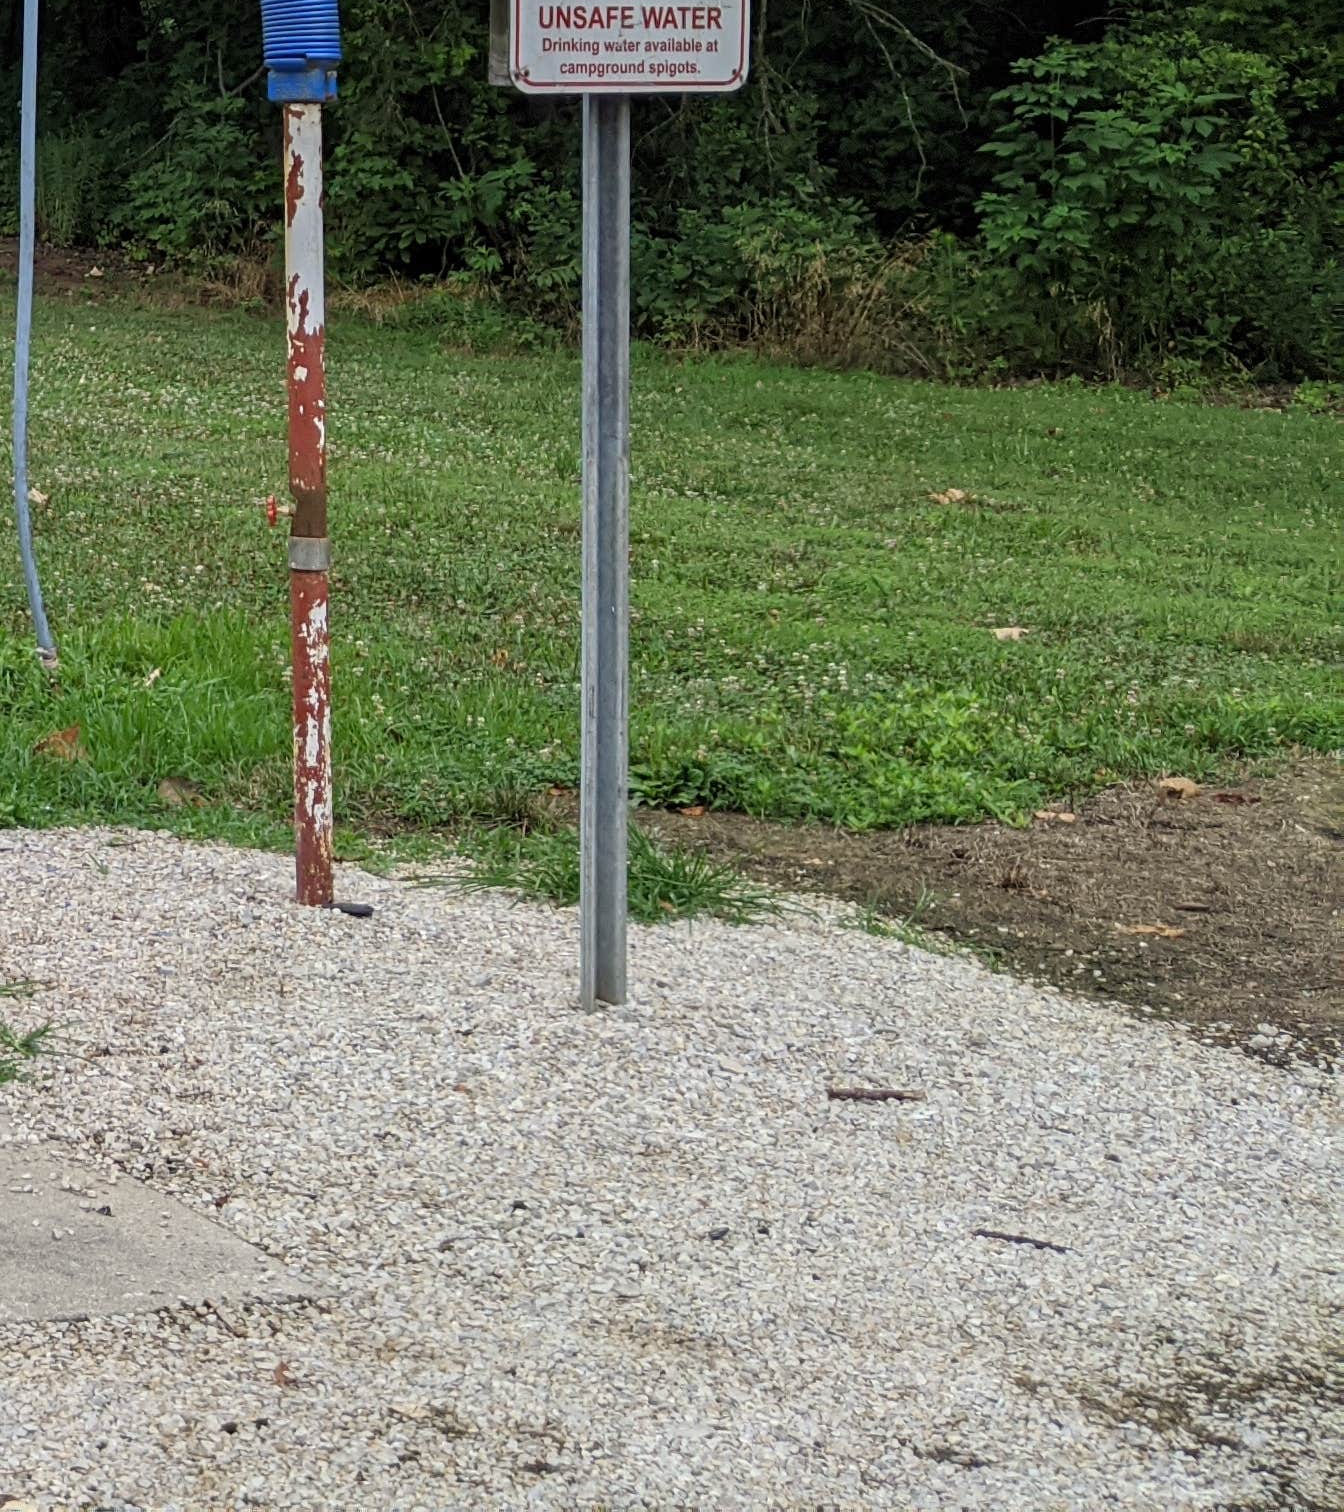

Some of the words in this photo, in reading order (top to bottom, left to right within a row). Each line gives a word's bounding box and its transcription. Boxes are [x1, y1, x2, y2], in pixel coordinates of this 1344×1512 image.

[539, 5, 634, 29] UNSAFE
[642, 6, 722, 29] WATER
[542, 37, 600, 55] Drinking
[604, 40, 640, 52] water
[644, 38, 702, 52] available
[706, 39, 719, 52] at
[559, 60, 645, 77] campground
[649, 62, 701, 77] spigots.
